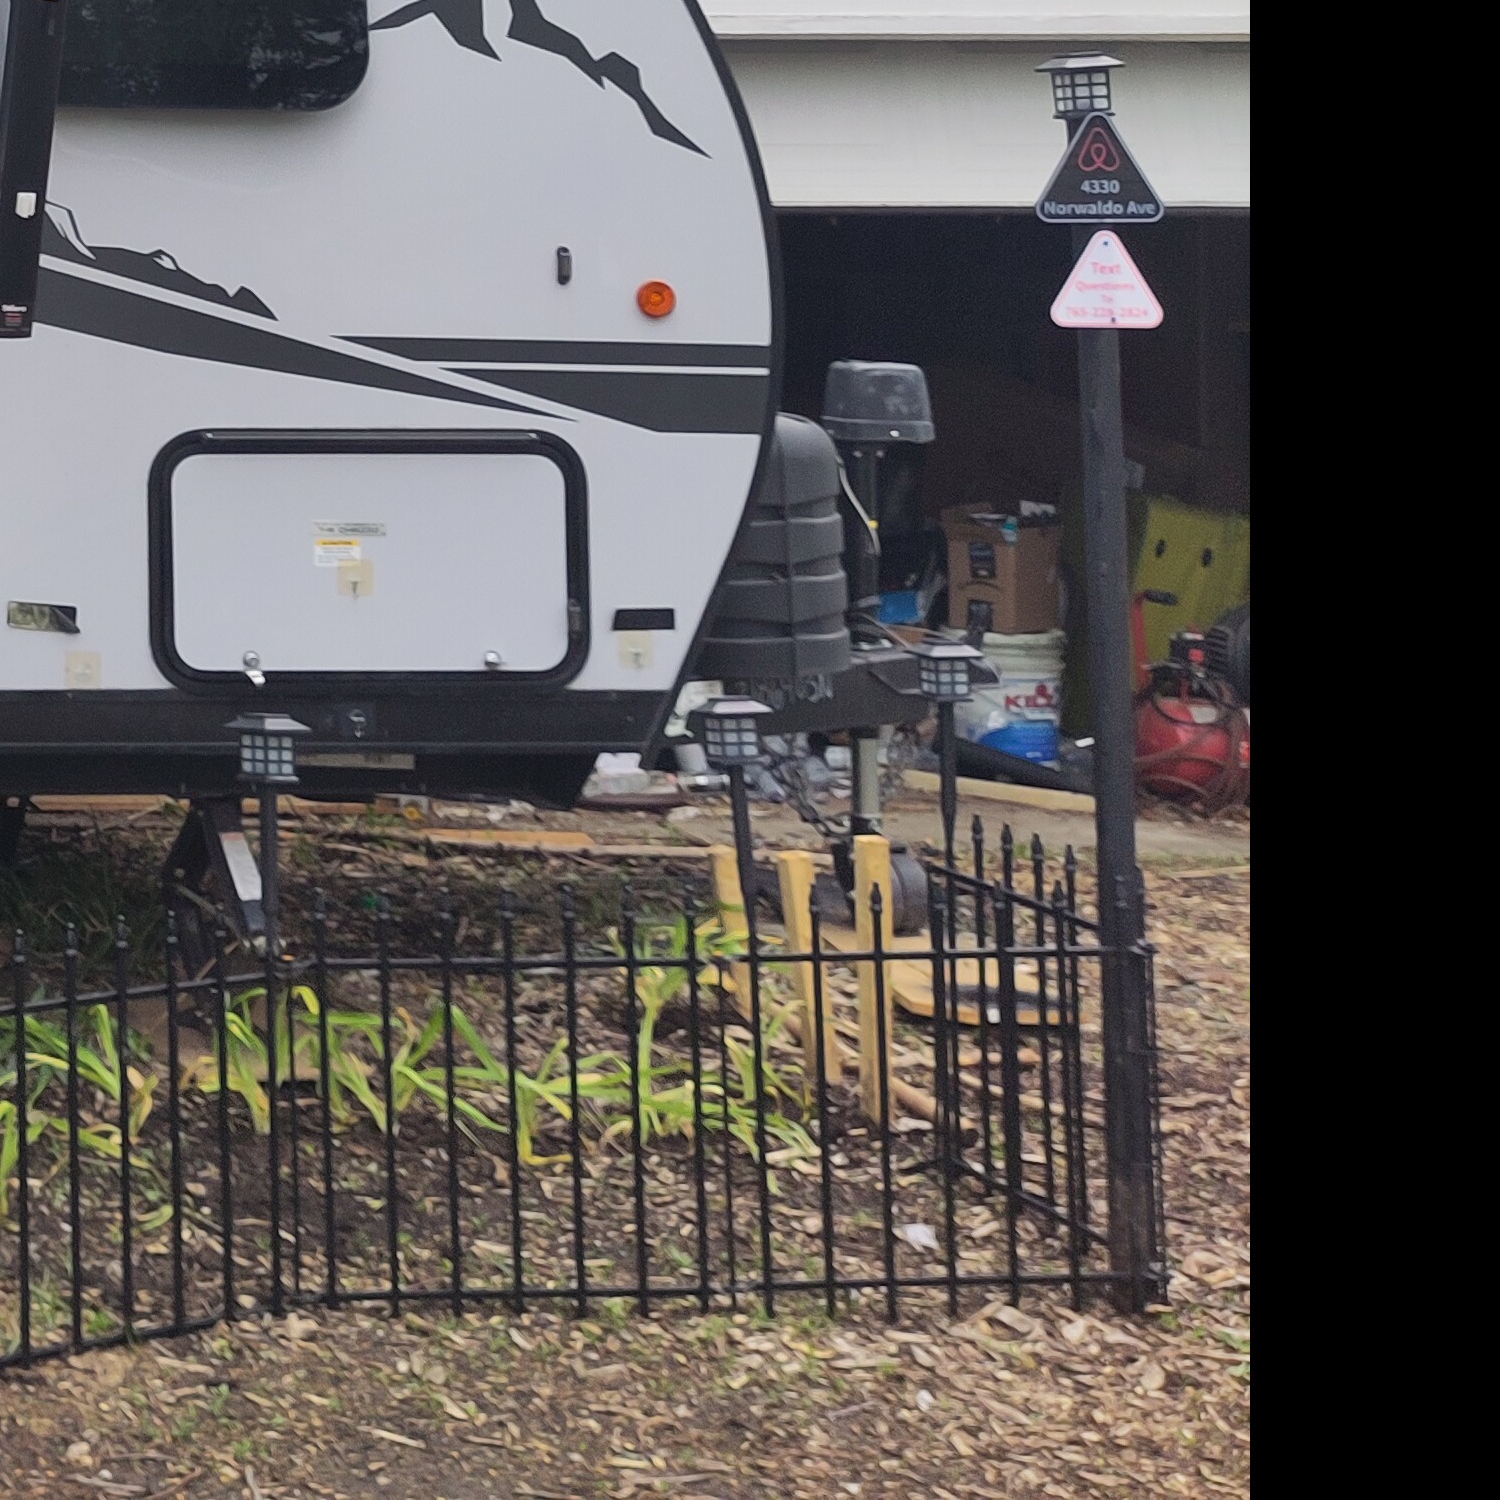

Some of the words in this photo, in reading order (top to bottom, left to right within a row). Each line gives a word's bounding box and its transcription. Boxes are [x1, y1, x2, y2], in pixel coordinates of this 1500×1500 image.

[1080, 179, 1120, 194] 4330
[1044, 201, 1124, 215] Norwaldo
[1126, 201, 1156, 215] Ave
[1091, 262, 1121, 274] Text
